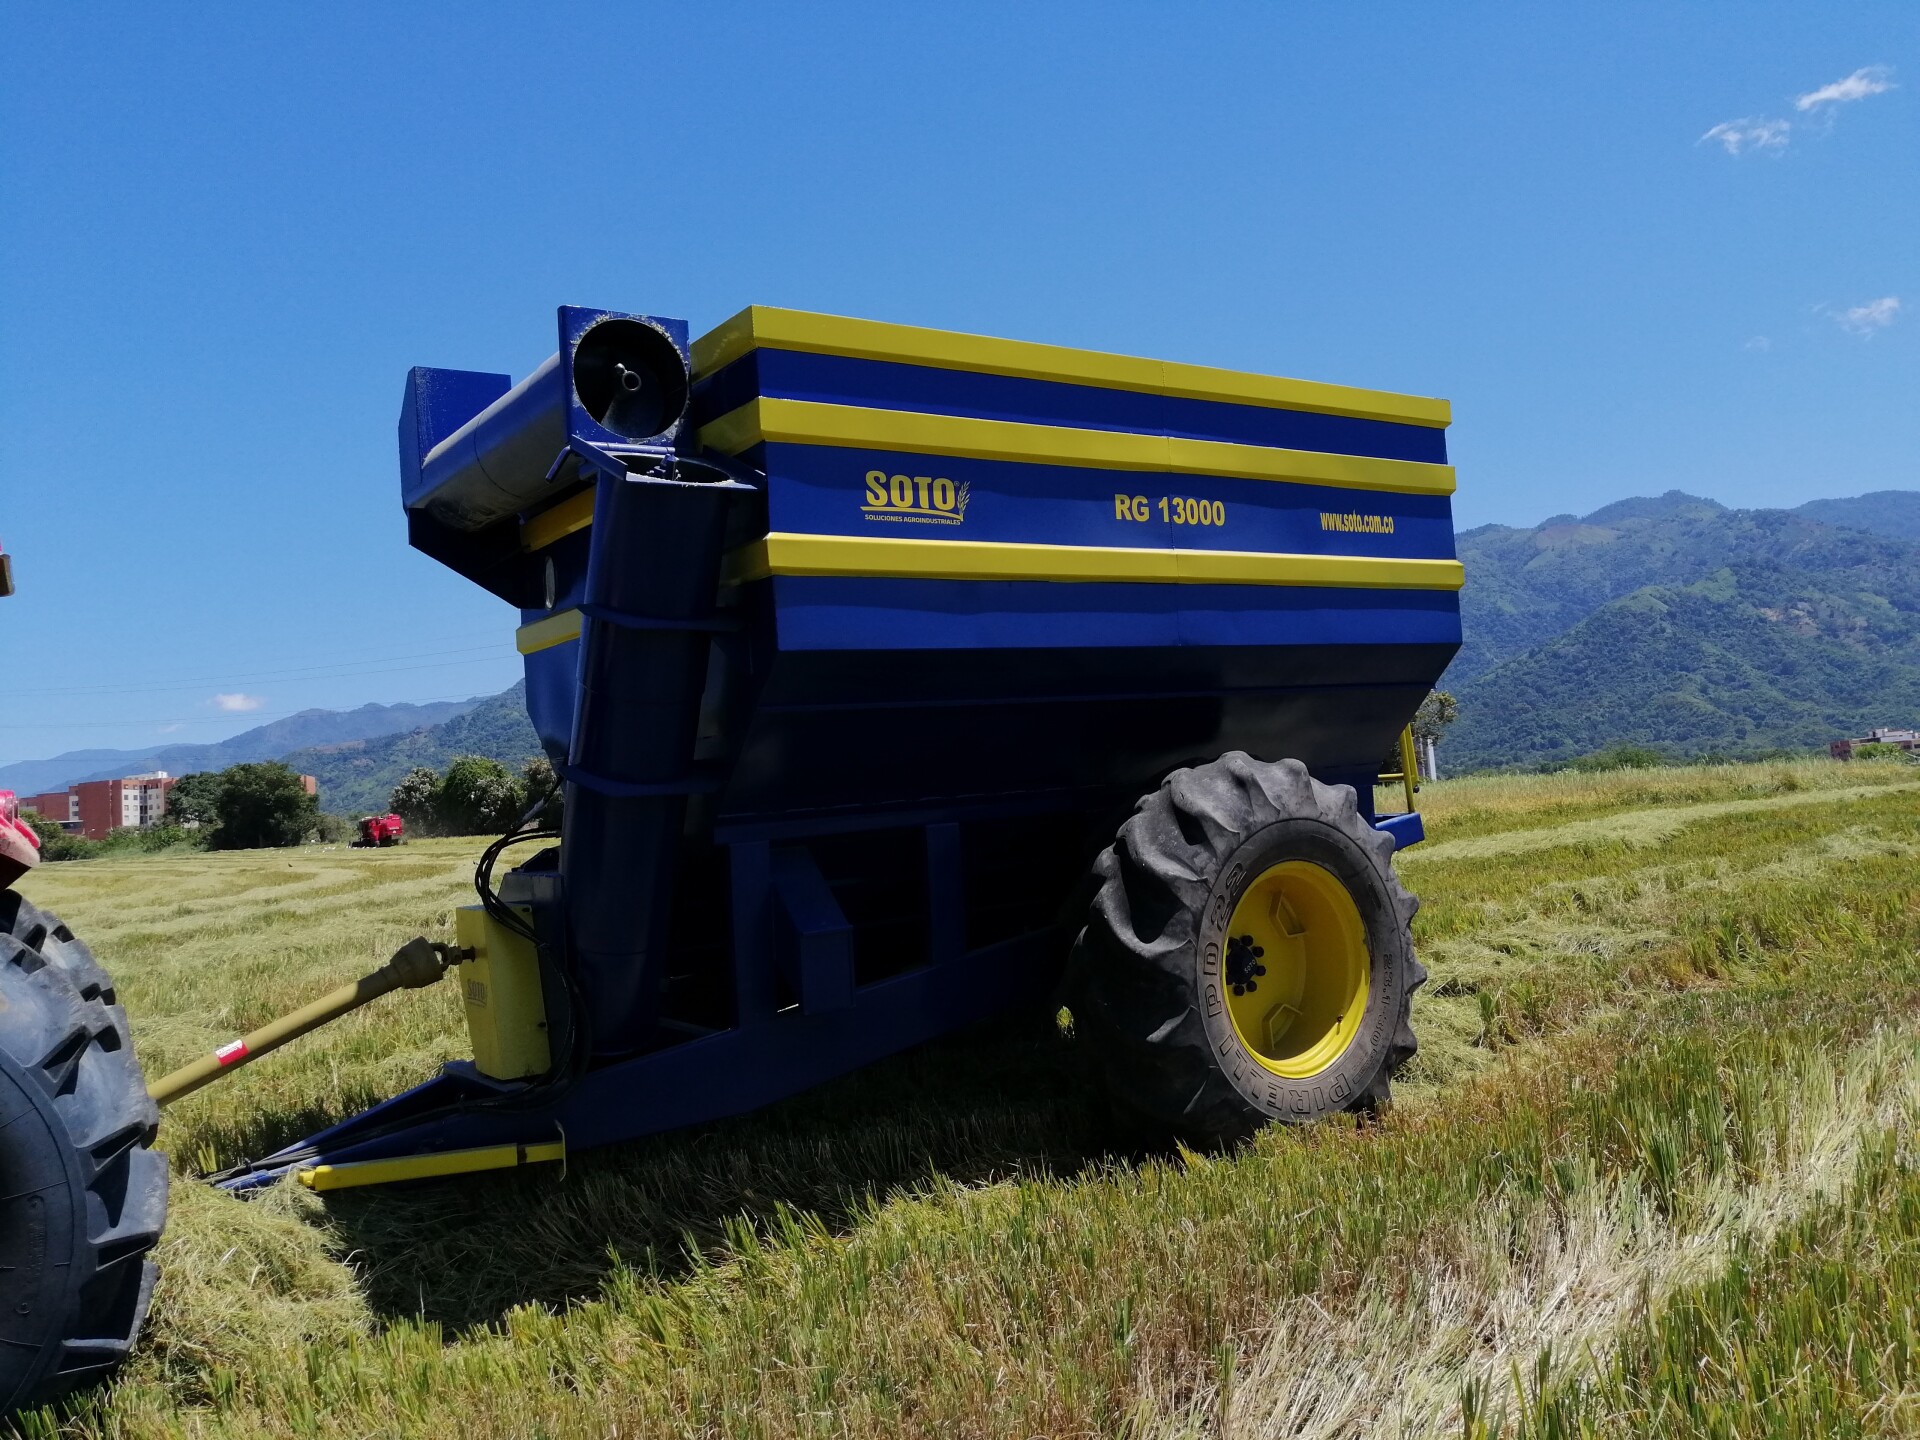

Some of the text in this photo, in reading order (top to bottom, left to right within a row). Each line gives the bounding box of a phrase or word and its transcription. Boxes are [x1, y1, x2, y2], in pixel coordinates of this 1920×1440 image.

[865, 470, 956, 511] SOTO
[864, 513, 961, 526] SOLUCIONES AGROINDUSTRIALES
[1114, 494, 1226, 526] RG 13000
[1319, 509, 1394, 534] www.soto.com.co
[1203, 862, 1352, 1115] PIRELLI PD 22
